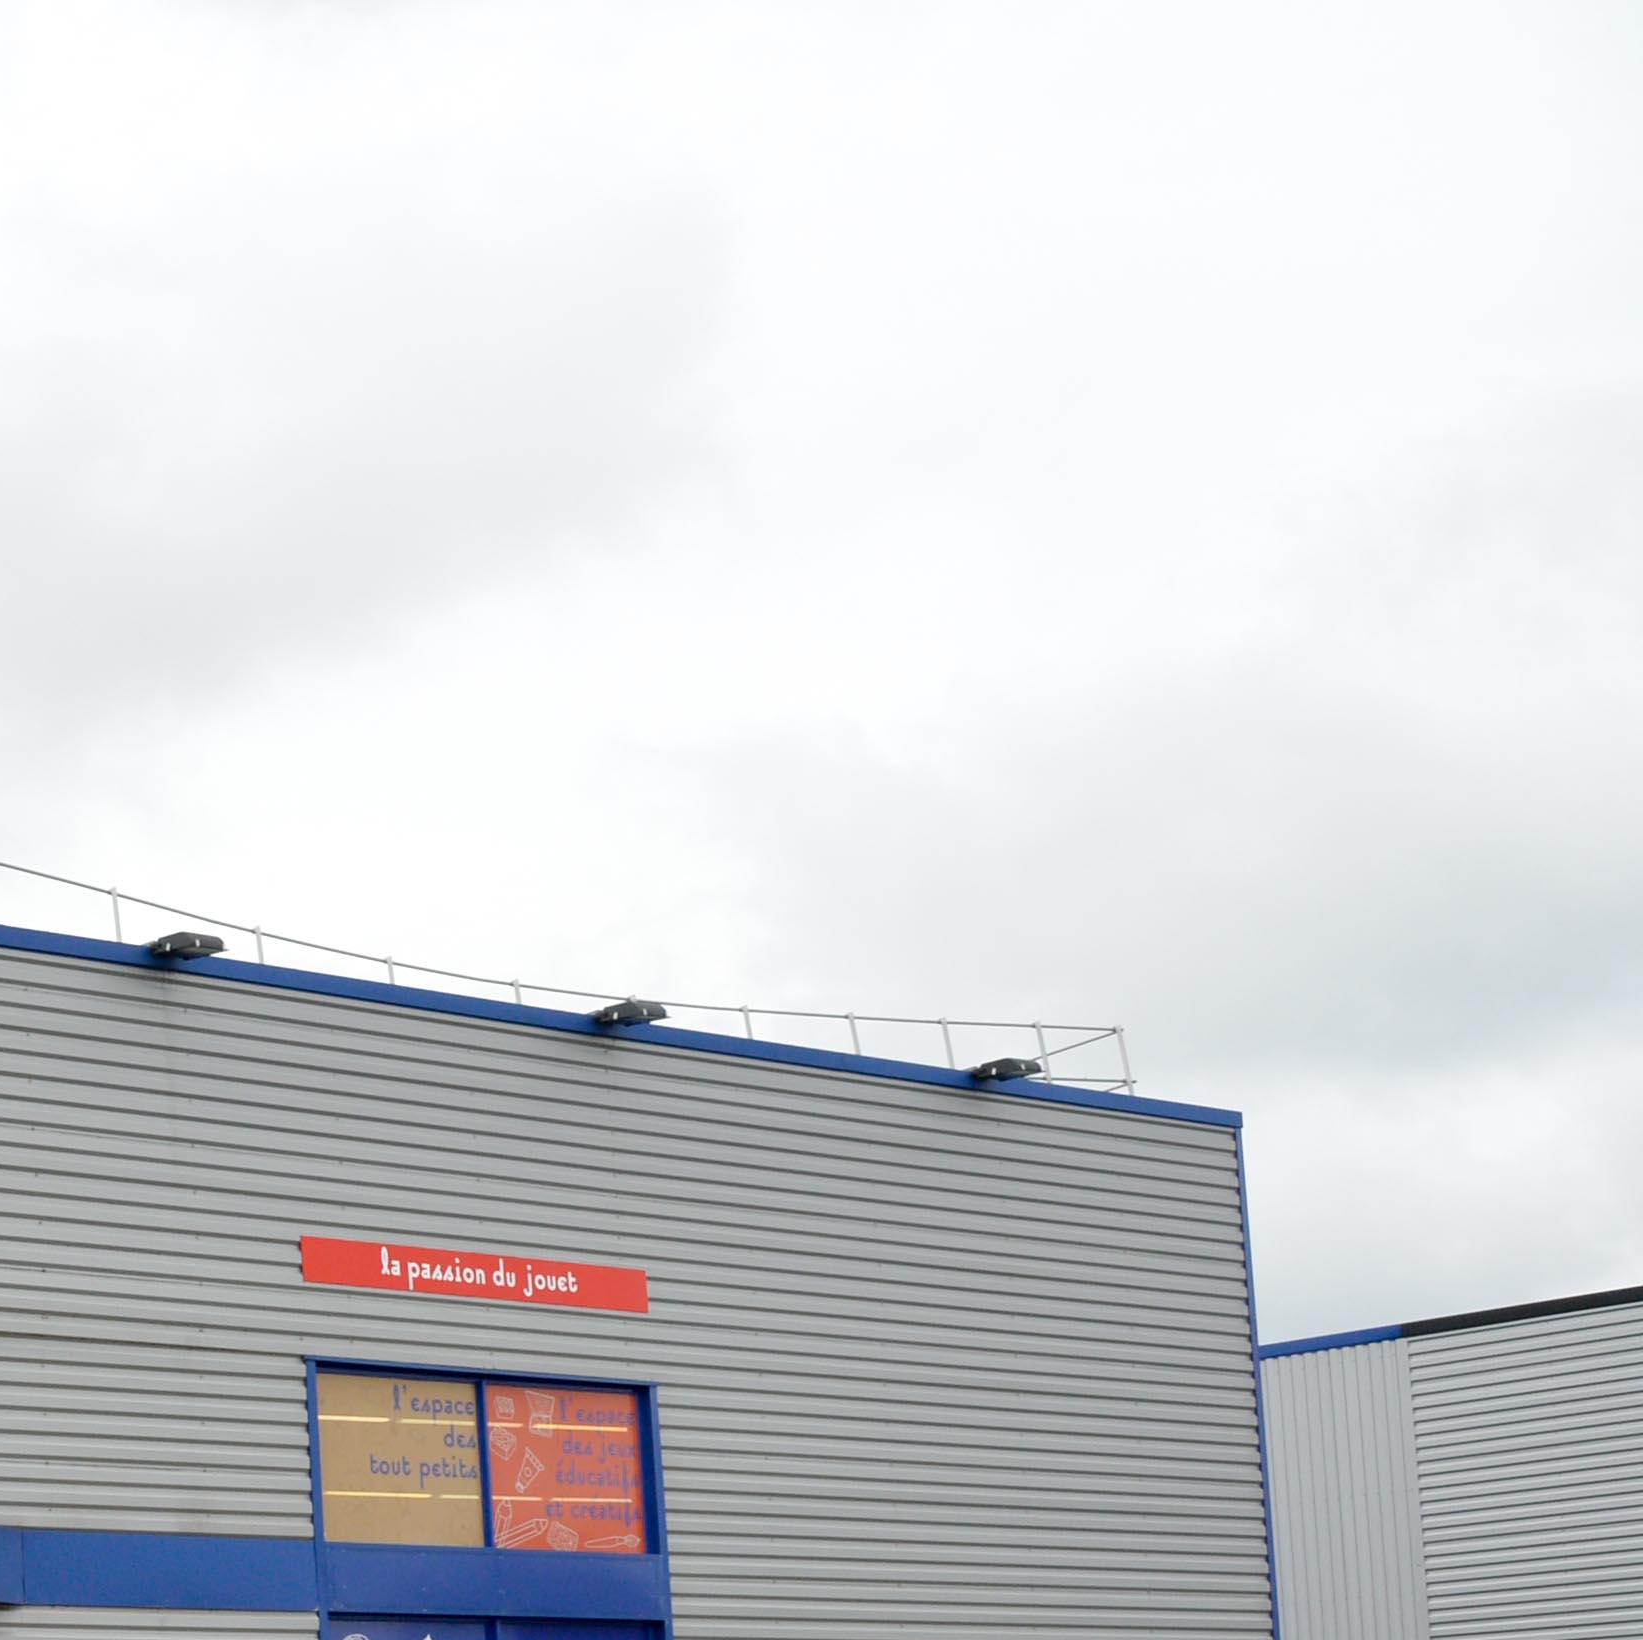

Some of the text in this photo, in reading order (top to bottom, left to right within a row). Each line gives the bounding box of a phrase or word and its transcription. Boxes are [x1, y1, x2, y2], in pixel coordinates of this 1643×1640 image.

[381, 1246, 578, 1297] la passion du jouet
[393, 1384, 474, 1421] l'espace
[444, 1425, 475, 1448] des
[370, 1454, 478, 1488] tout petits
